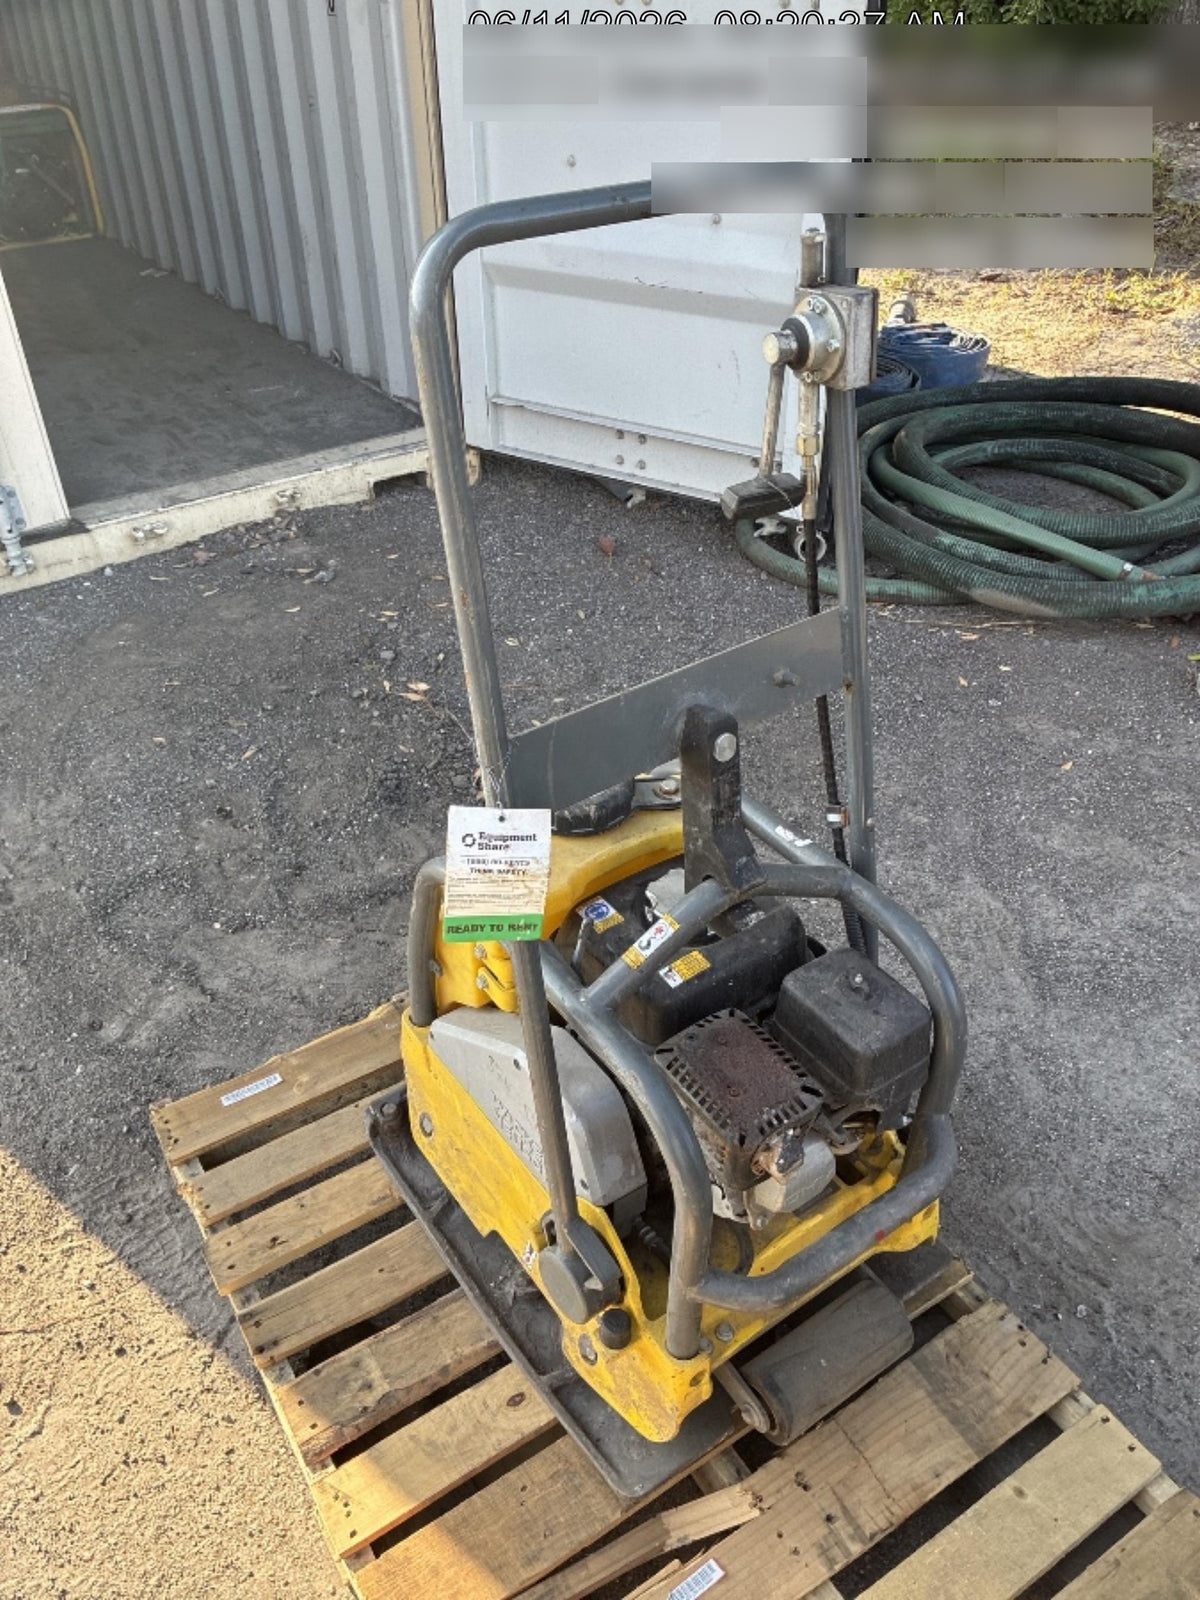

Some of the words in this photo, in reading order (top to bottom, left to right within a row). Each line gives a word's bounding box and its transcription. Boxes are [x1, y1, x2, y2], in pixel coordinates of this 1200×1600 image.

[447, 924, 485, 934] READY
[489, 923, 503, 932] TO
[508, 923, 538, 933] RENT
